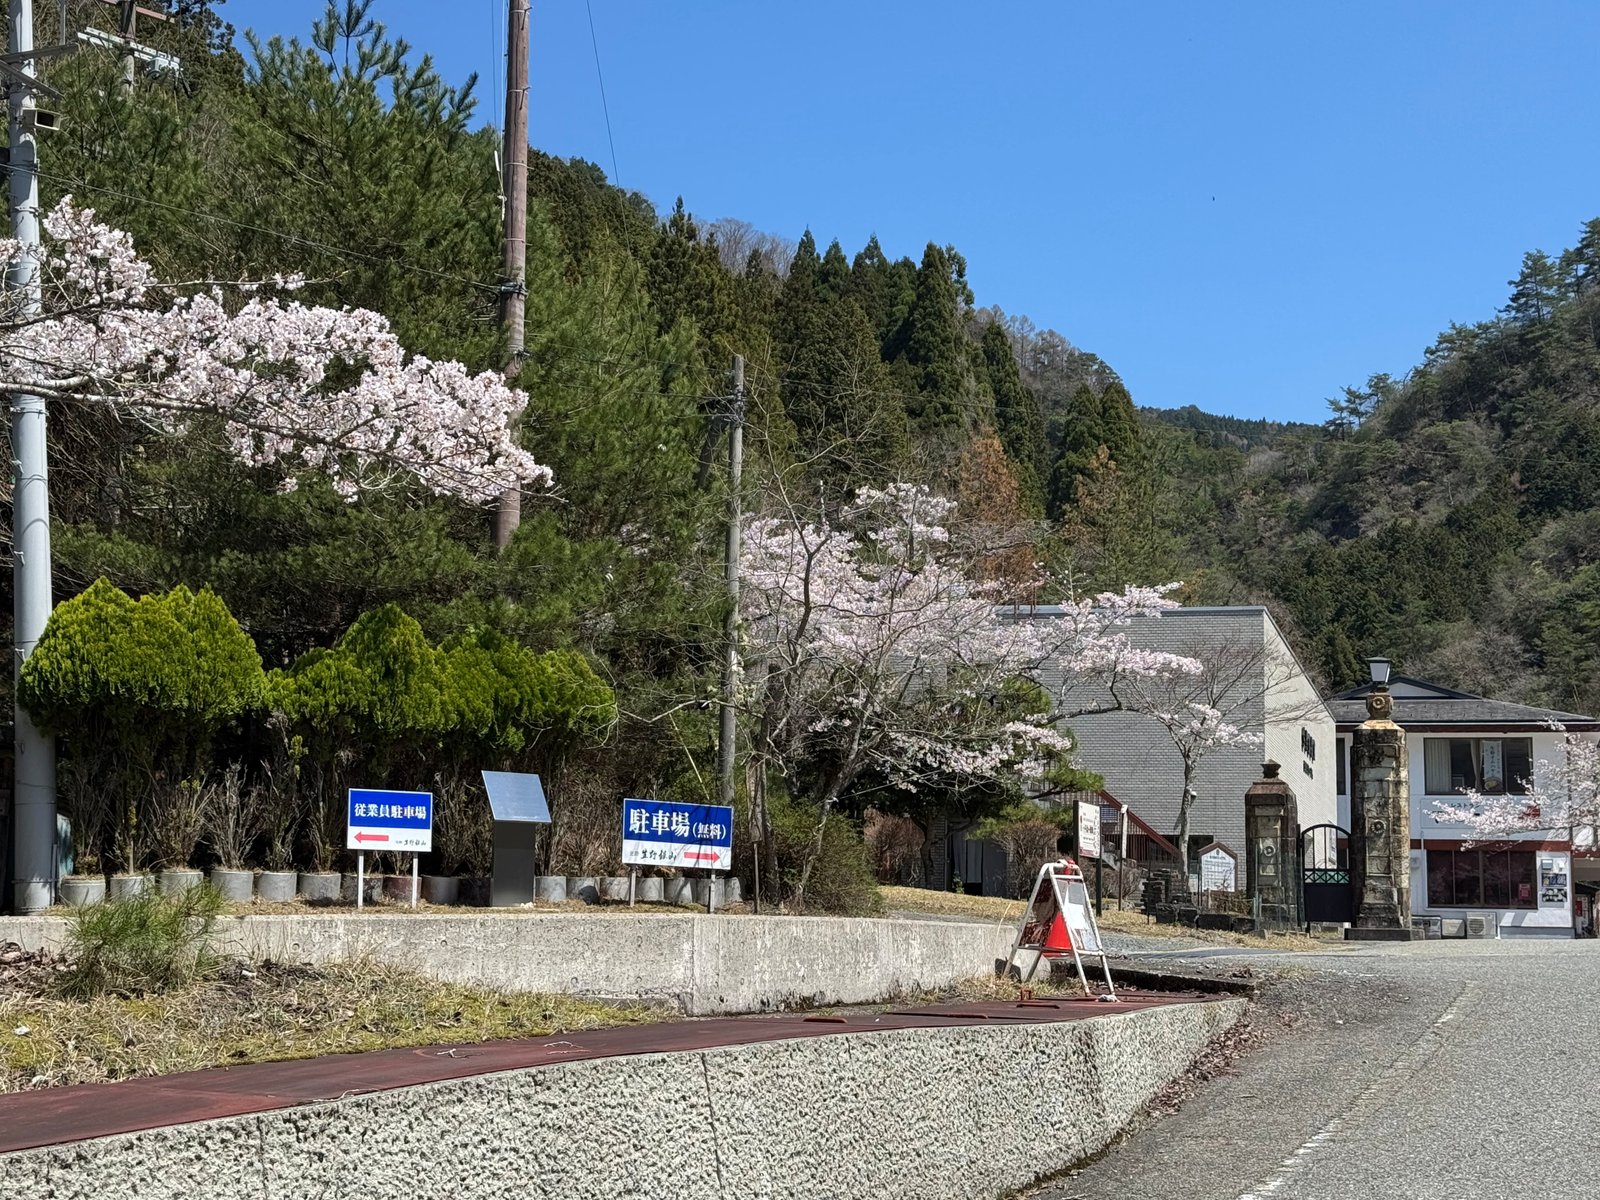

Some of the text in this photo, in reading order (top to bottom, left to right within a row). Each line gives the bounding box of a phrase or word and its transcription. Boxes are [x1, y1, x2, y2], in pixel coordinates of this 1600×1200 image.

[354, 802, 427, 820] 従業員駐車場
